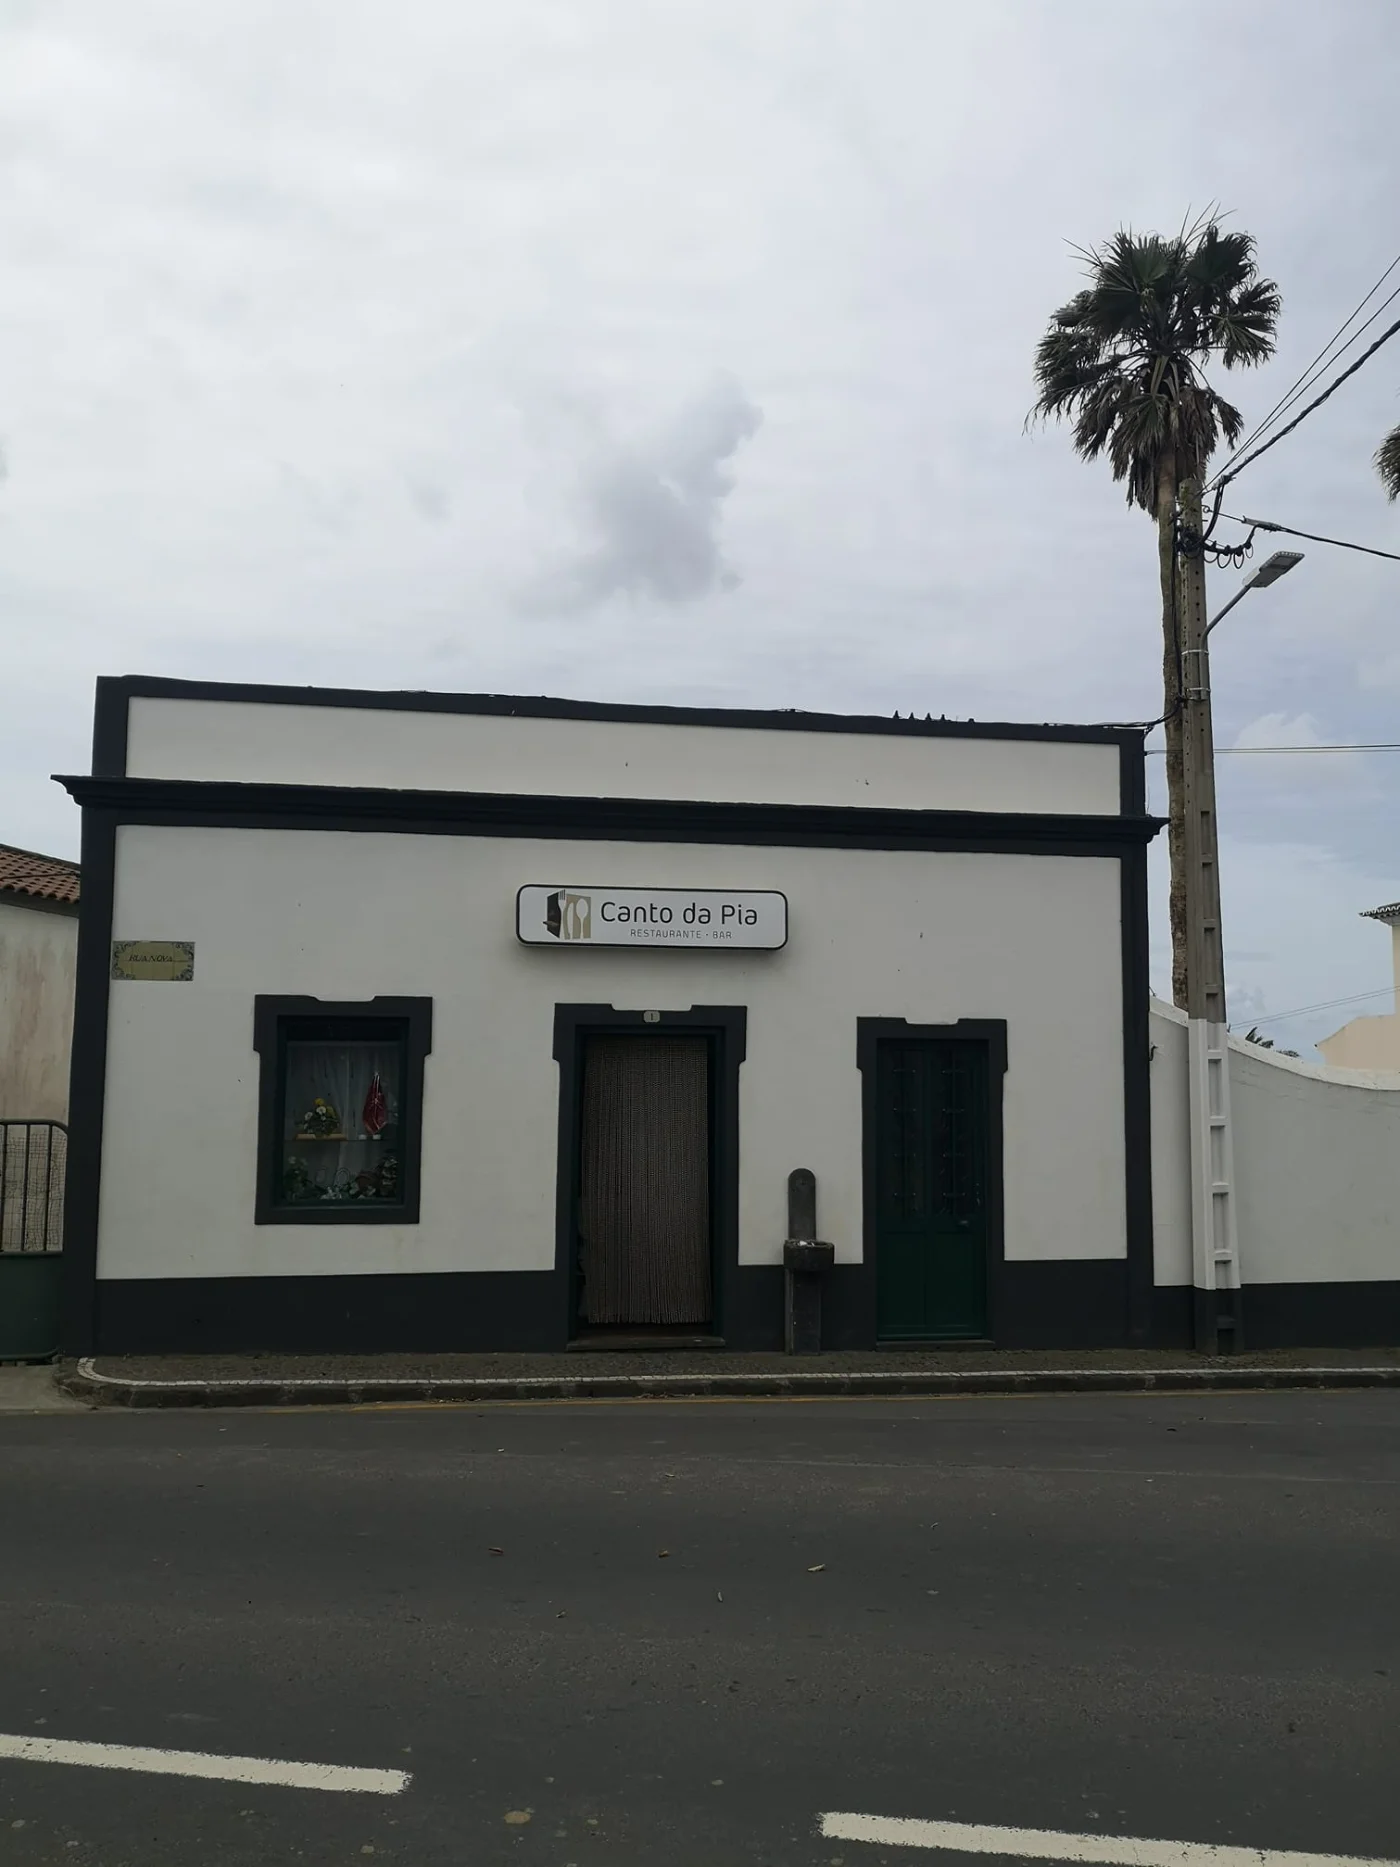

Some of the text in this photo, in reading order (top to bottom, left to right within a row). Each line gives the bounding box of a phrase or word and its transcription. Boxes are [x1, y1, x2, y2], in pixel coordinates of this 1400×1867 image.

[600, 901, 758, 925] Canto da Pia
[630, 928, 732, 940] RESTAURANTE BAR
